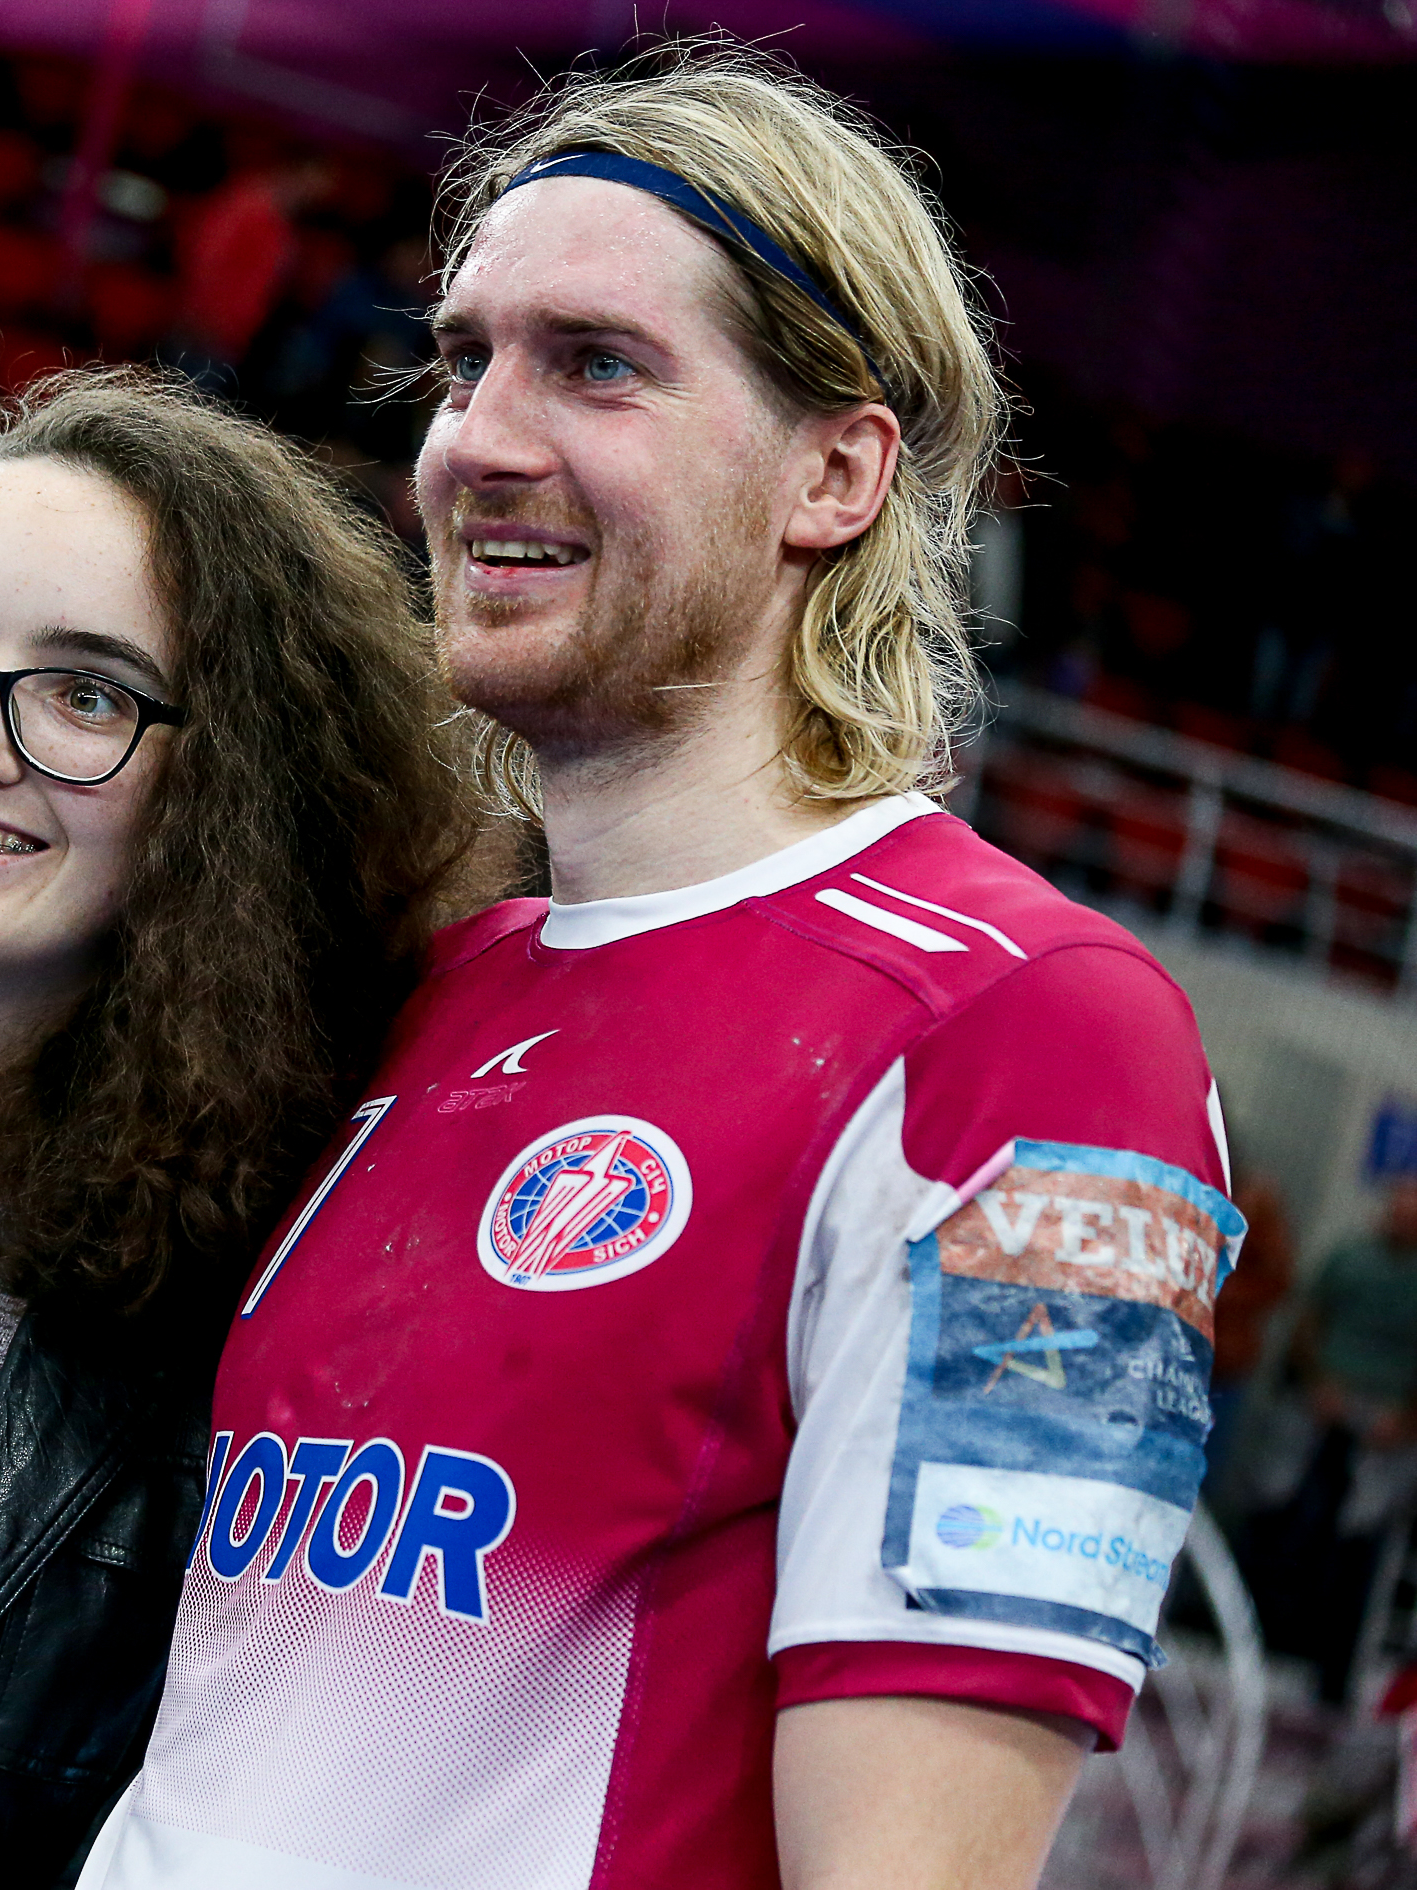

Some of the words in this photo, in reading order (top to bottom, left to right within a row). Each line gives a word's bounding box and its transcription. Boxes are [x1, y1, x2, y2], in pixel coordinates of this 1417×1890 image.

[493, 1203, 519, 1257] MOTOR
[593, 1228, 647, 1263] SICH
[1011, 1516, 1102, 1560] Nord
